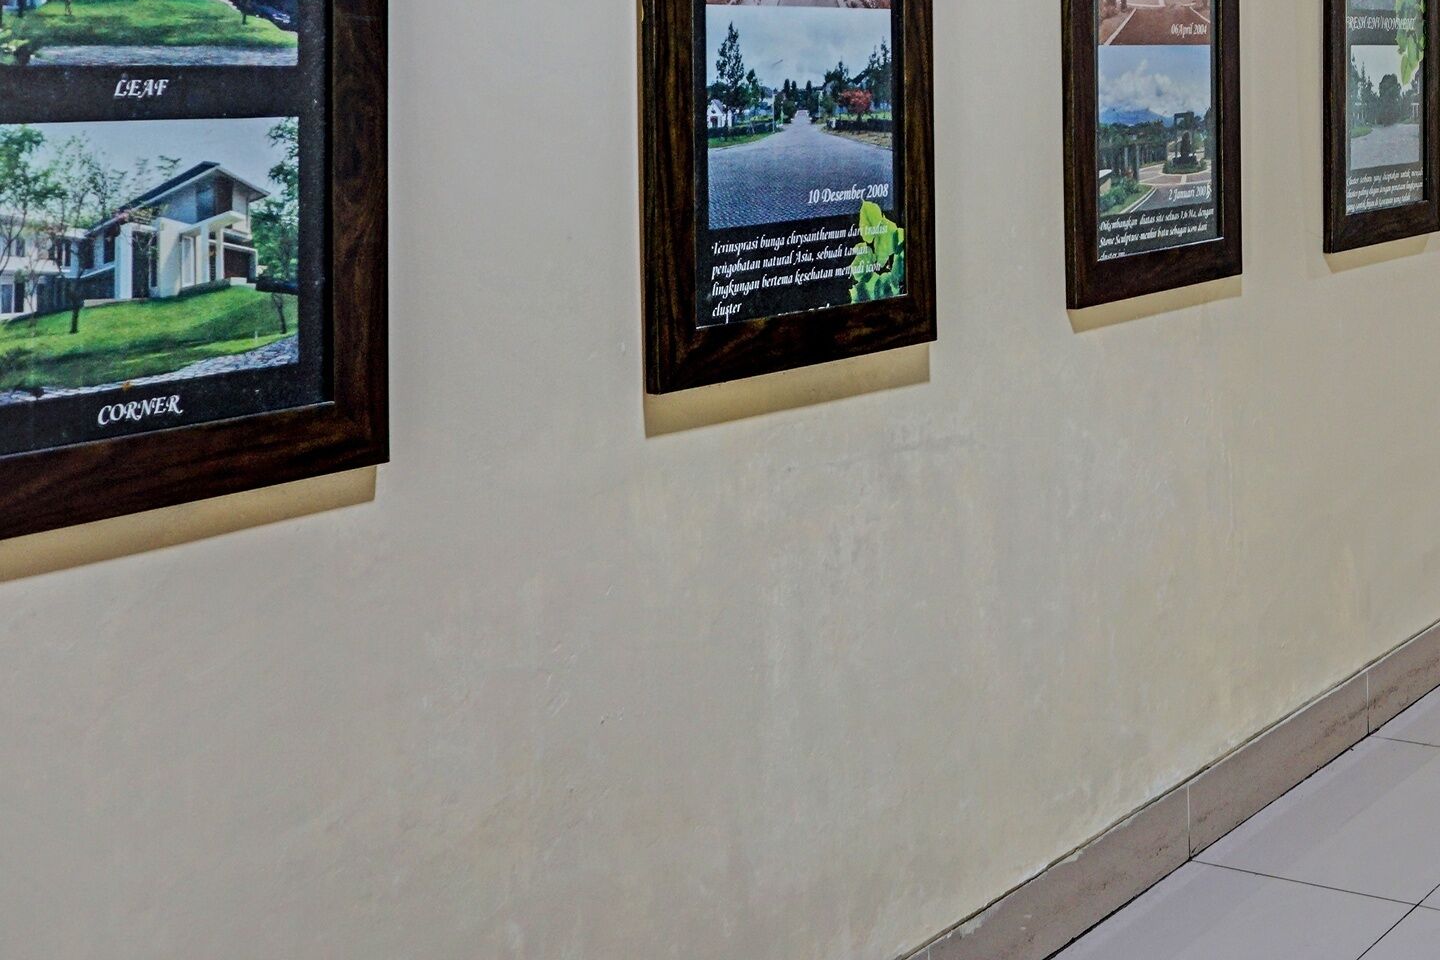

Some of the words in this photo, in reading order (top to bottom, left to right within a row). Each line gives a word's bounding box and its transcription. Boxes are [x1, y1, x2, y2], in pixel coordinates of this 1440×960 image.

[113, 78, 169, 98] LEAF
[808, 189, 820, 204] 10
[821, 184, 866, 203] Desember
[867, 183, 889, 199] 2008
[760, 233, 785, 251] bunga
[787, 226, 847, 248] chrysanthemum
[711, 257, 761, 280] pengobatan
[762, 249, 795, 268] natural
[792, 245, 814, 266] Asia,
[815, 243, 843, 260] sebuah
[711, 279, 760, 299] lingkungan
[761, 273, 794, 288] bertema
[794, 266, 834, 285] kesehatan
[712, 301, 743, 317] cluster
[97, 394, 184, 426] CORNER
